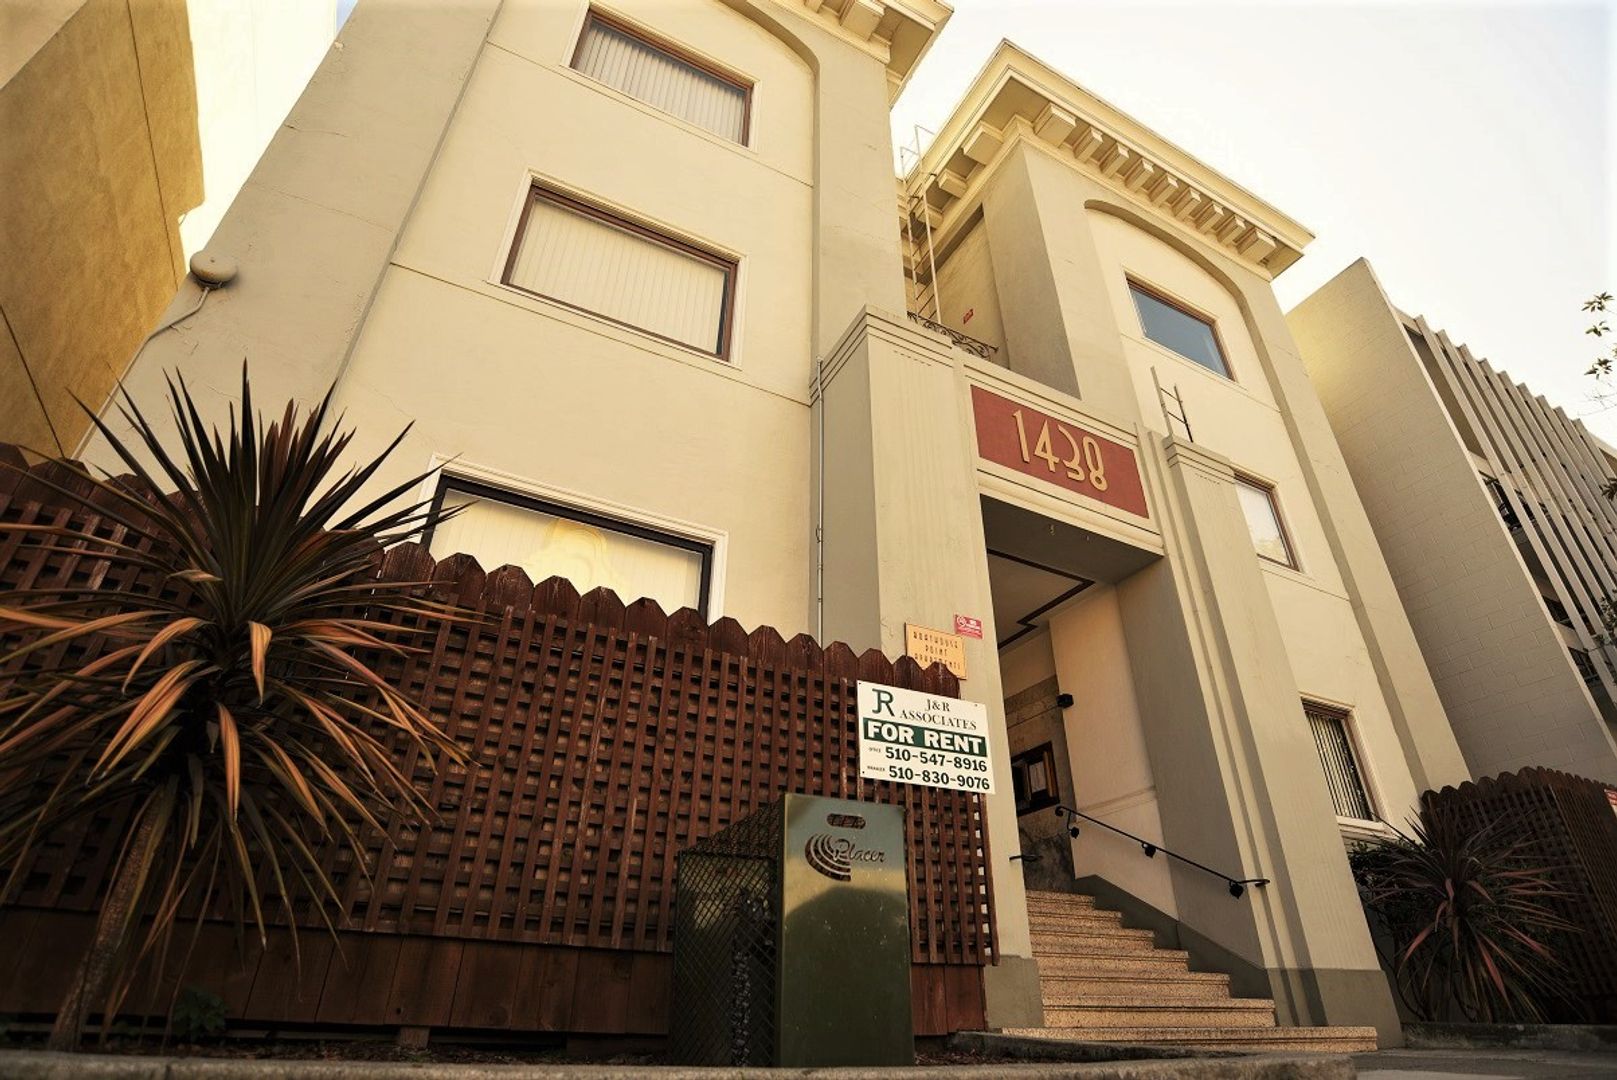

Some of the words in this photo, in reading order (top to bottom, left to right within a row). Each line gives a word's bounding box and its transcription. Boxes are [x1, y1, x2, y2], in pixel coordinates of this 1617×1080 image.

[1012, 410, 1108, 492] 1438
[925, 698, 950, 712] J&R
[899, 710, 977, 730] ASSOCIATES
[867, 720, 915, 744] FOR
[924, 729, 983, 754] RENT
[885, 746, 988, 772] 510-547-8916
[889, 765, 991, 790] 510-830-9076
